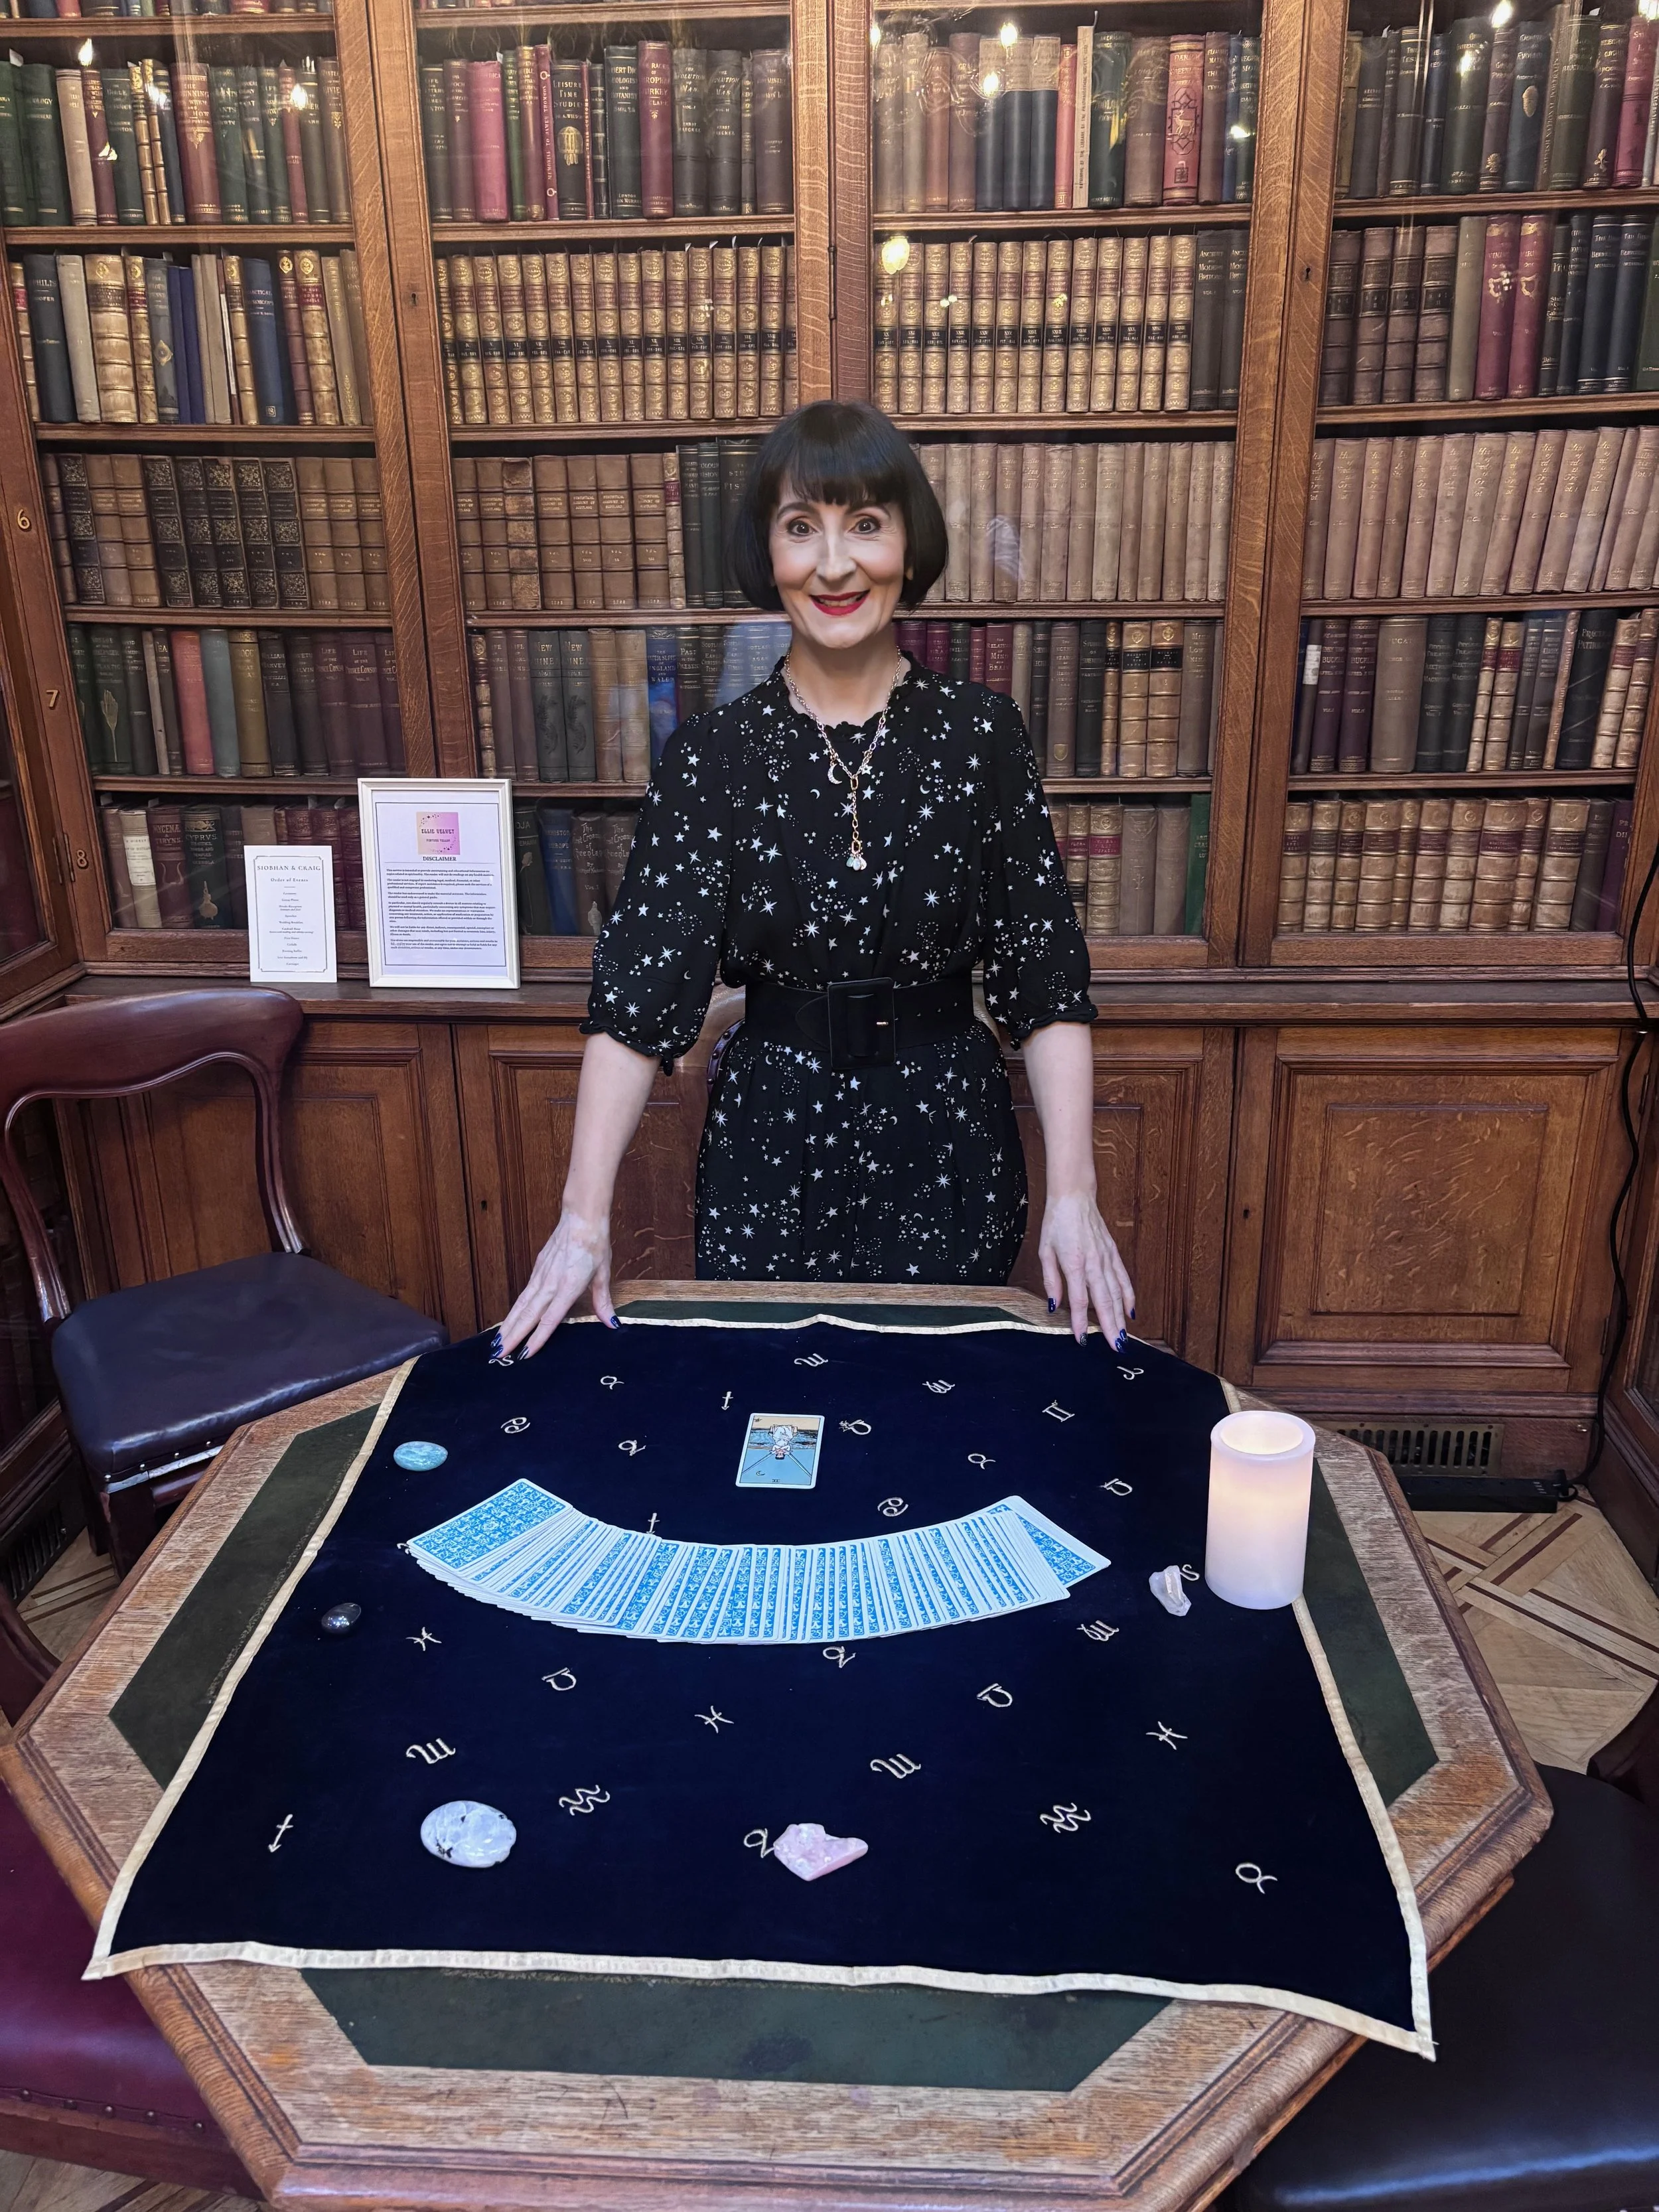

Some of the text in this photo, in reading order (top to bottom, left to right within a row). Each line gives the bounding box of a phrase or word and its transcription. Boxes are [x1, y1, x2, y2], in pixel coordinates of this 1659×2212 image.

[559, 89, 577, 98] TIME
[17, 509, 30, 529] 6
[46, 689, 59, 707] 7
[76, 849, 87, 867] 8
